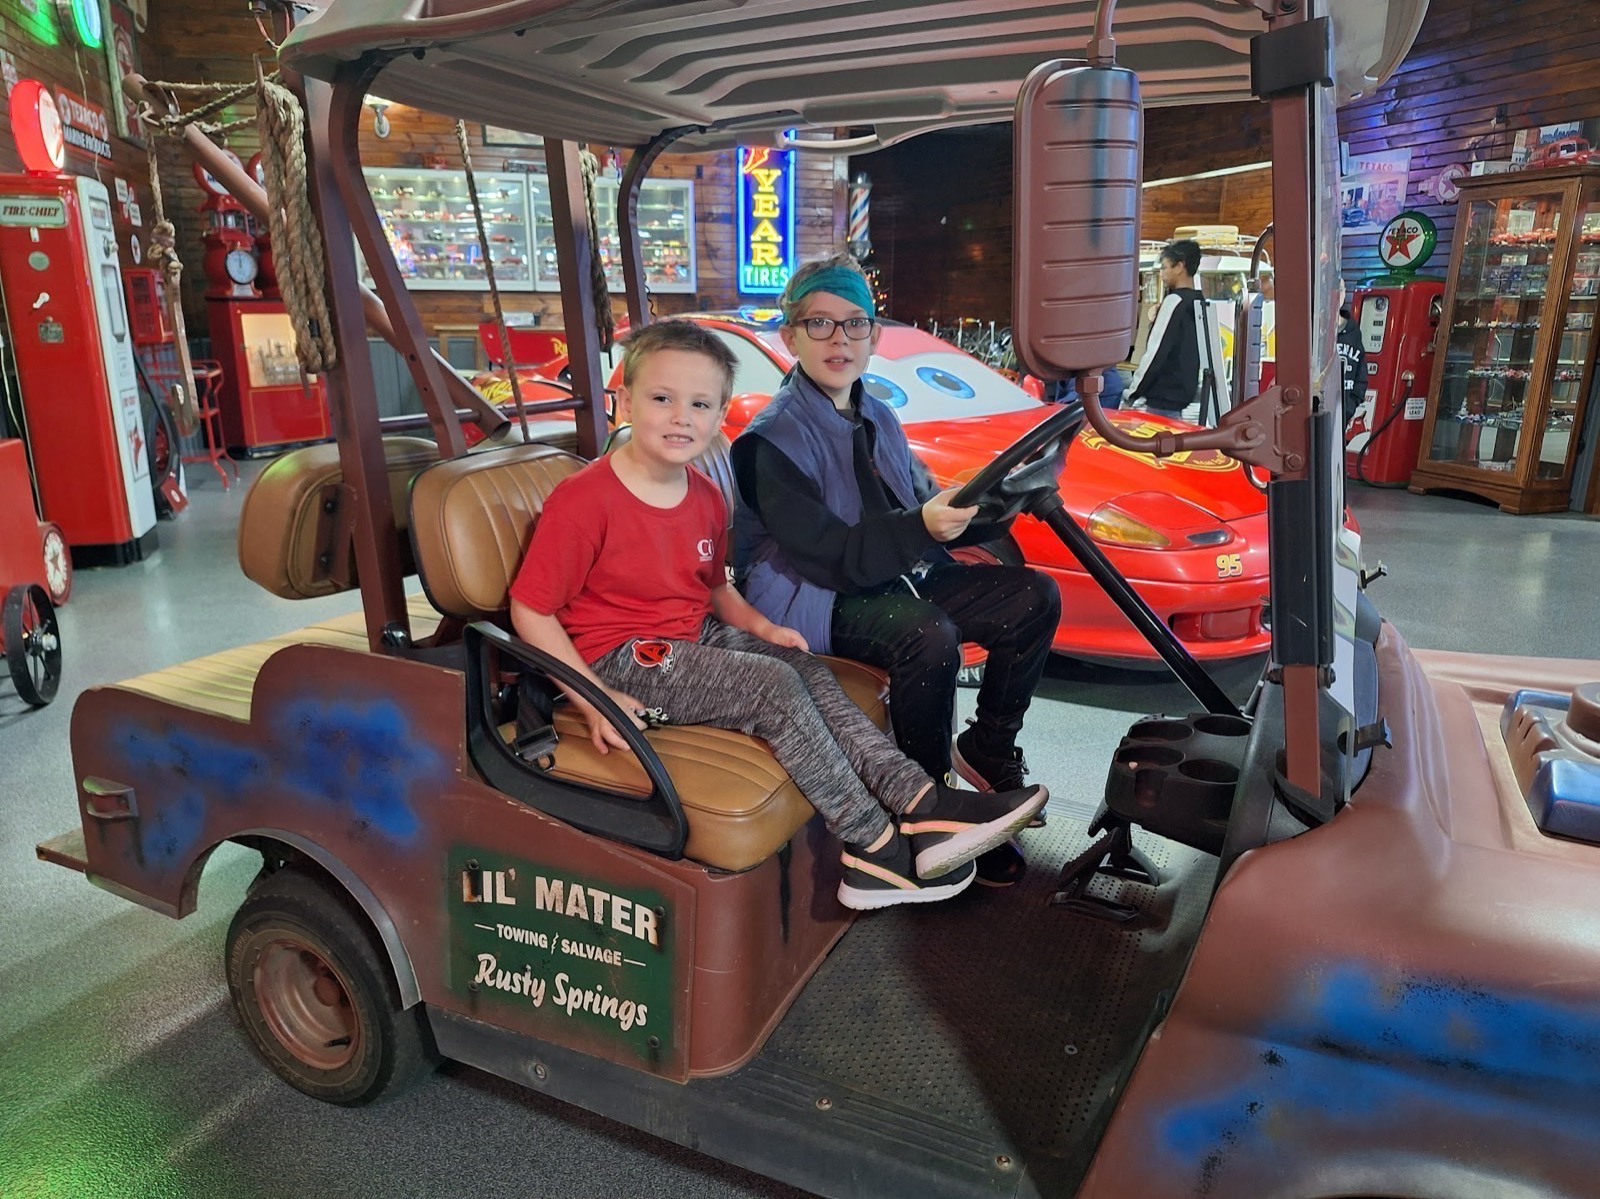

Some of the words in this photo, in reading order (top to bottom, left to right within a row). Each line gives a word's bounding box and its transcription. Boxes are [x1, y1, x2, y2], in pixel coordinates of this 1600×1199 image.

[1360, 161, 1394, 172] TEXACO
[744, 268, 788, 286] TIRES
[1216, 554, 1243, 578] 95
[535, 875, 660, 946] MATER
[496, 924, 548, 949] TOWING
[561, 938, 622, 967] SALVAGE
[474, 953, 546, 1008] Rusty
[552, 972, 648, 1031] Springs
